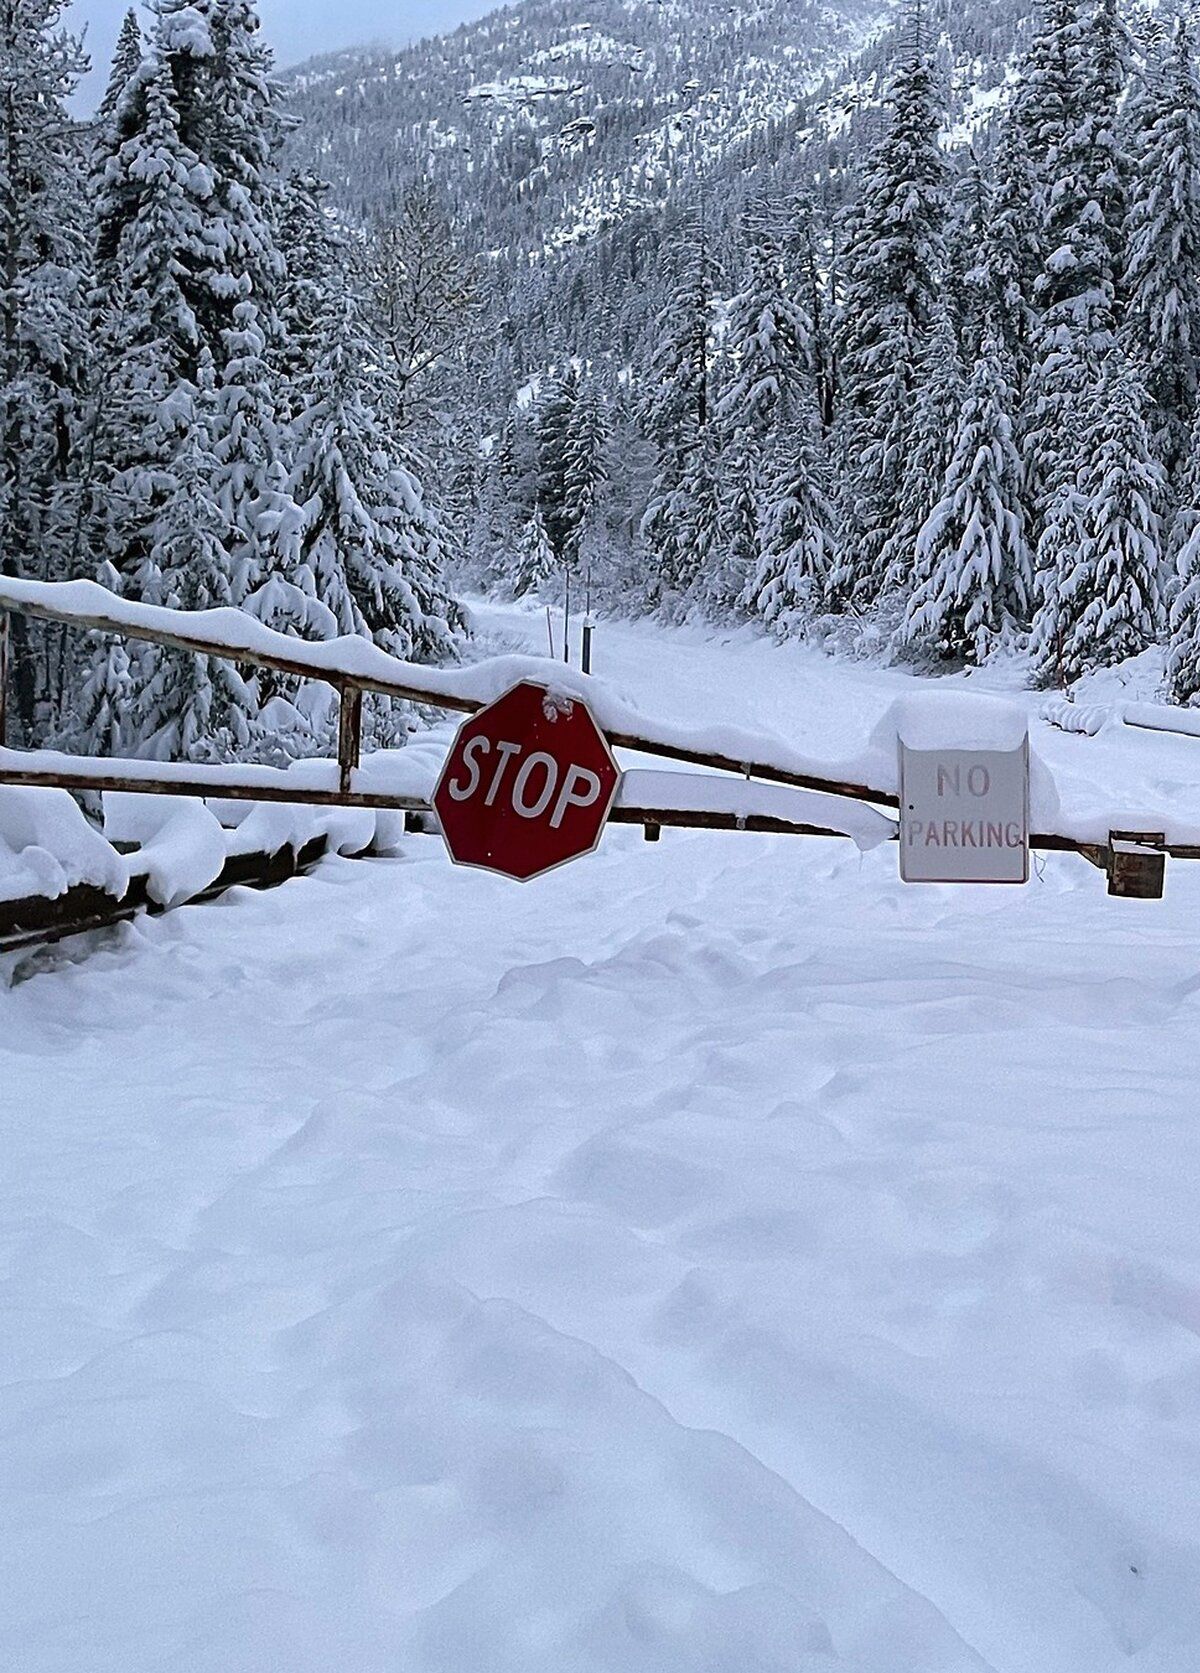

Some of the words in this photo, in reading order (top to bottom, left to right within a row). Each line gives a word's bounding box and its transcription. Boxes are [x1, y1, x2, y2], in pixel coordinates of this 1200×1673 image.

[449, 735, 601, 829] STOP
[937, 764, 990, 797] NO
[908, 820, 1020, 848] PARKING
